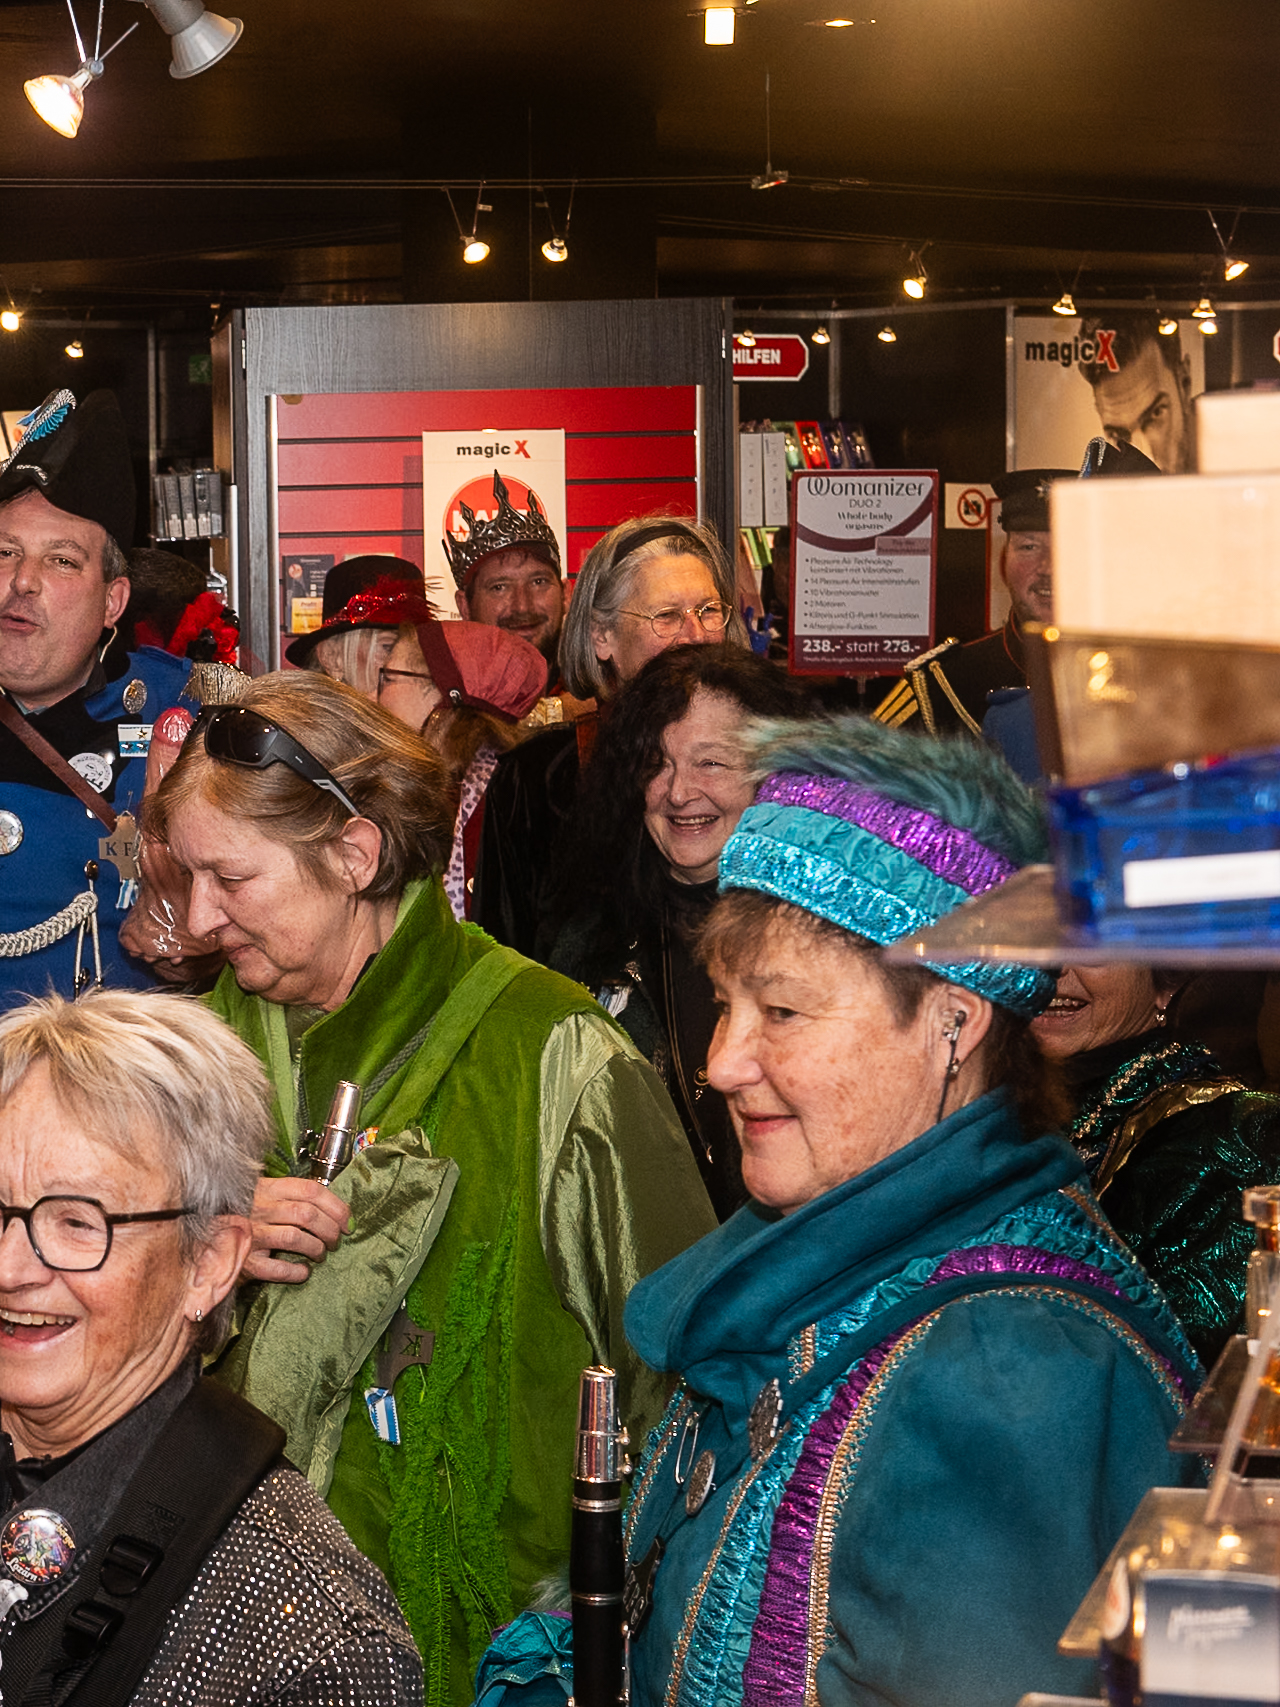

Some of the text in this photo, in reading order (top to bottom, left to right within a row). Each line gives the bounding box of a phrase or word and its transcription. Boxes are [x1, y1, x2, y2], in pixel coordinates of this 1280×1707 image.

[732, 349, 781, 365] HILFEN
[807, 477, 924, 496] Womanizer
[849, 498, 882, 508] DUO 2
[846, 640, 880, 653] statt
